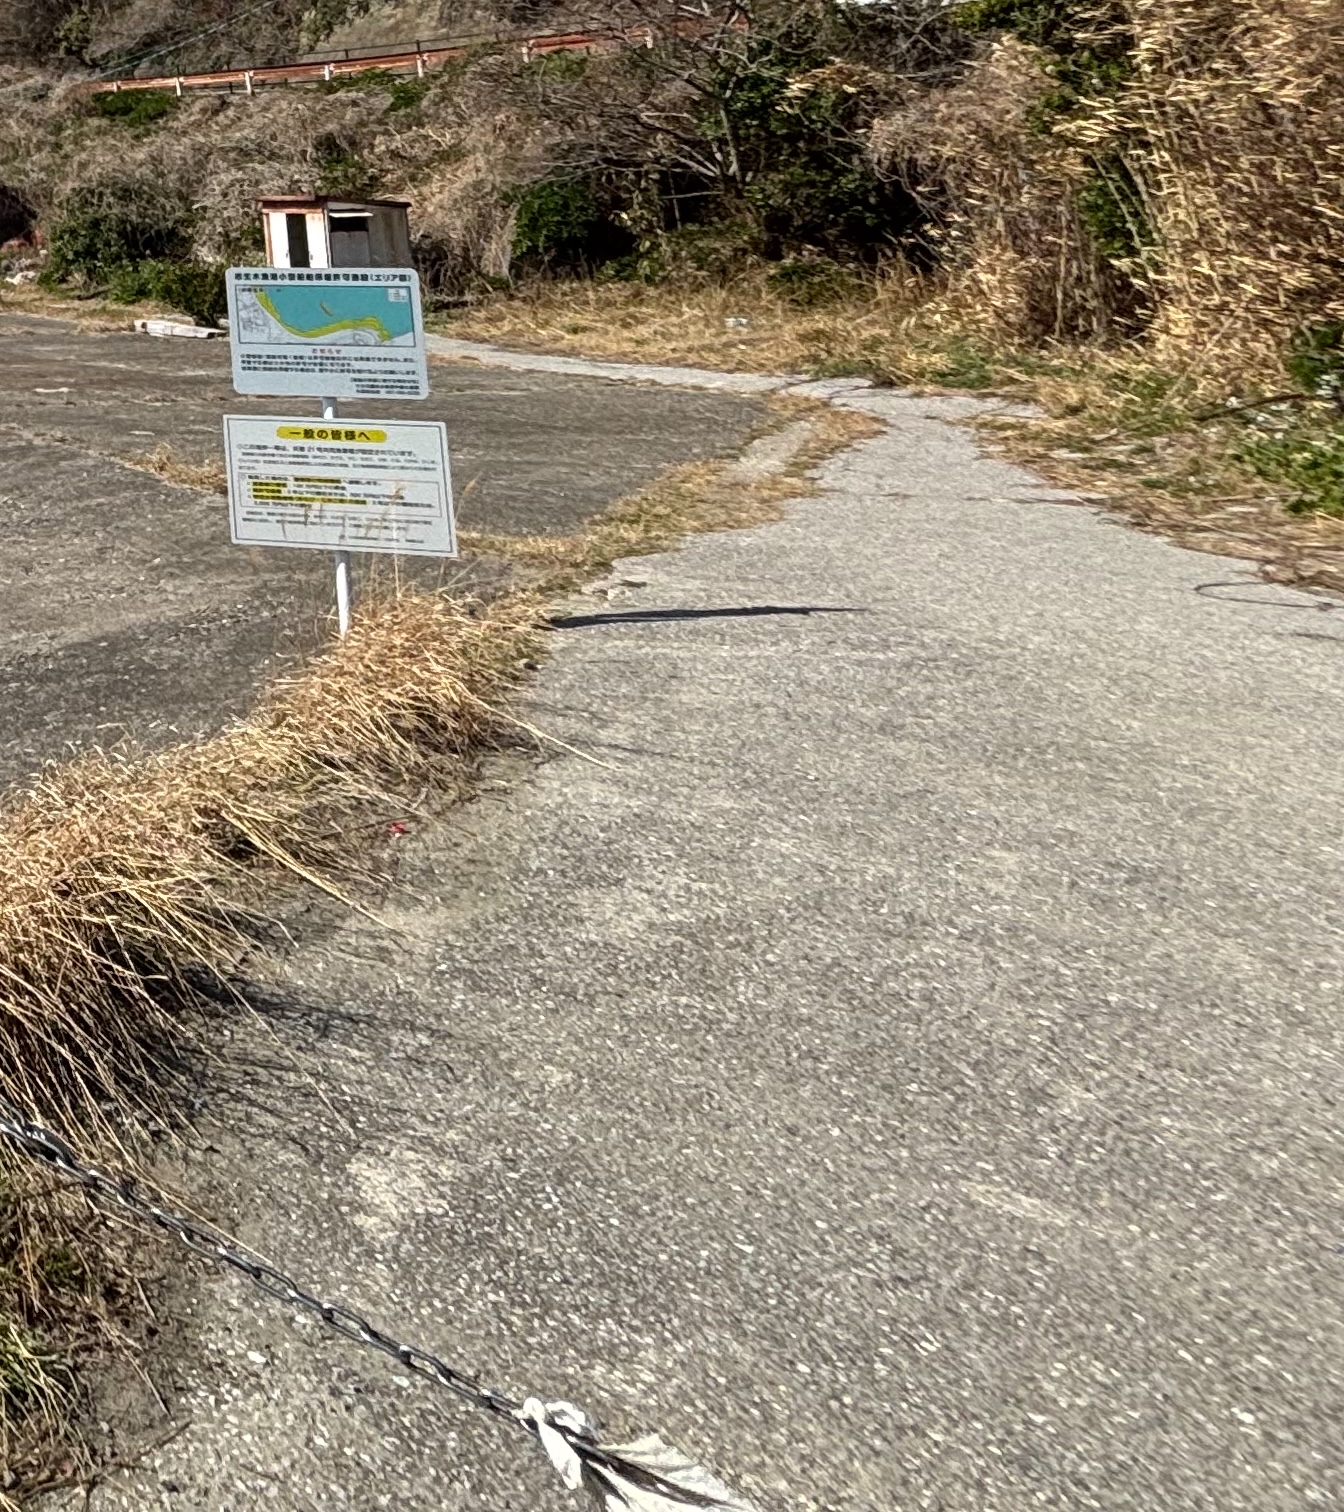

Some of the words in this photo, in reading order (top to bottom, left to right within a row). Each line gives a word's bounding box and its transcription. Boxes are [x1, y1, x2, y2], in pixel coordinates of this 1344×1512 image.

[289, 428, 372, 441] 一般の皆様へ
